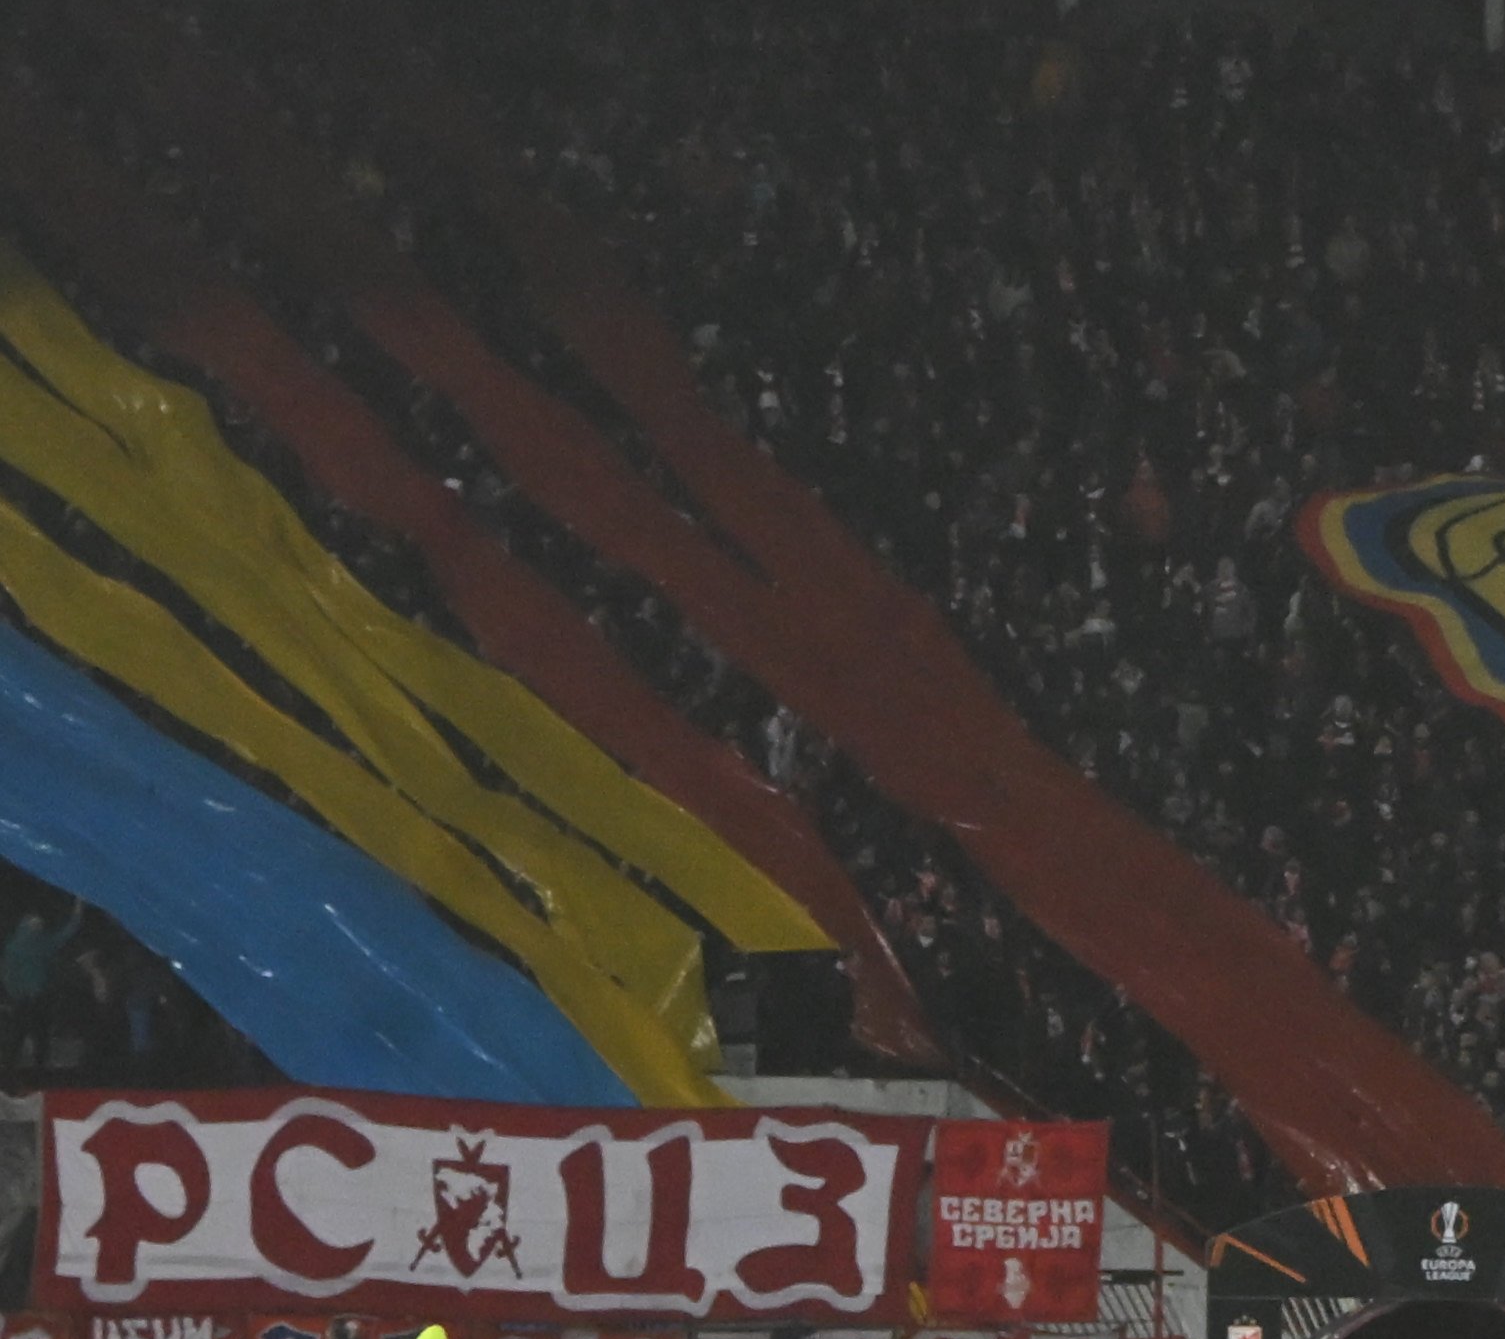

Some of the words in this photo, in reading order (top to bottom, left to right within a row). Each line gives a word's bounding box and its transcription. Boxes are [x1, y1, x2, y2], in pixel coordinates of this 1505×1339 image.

[939, 1196, 1096, 1225] СЕВЕРНА
[952, 1223, 1082, 1250] СРБИЈА
[1420, 1258, 1476, 1271] EUROPA
[1425, 1270, 1473, 1282] LEAGUE
